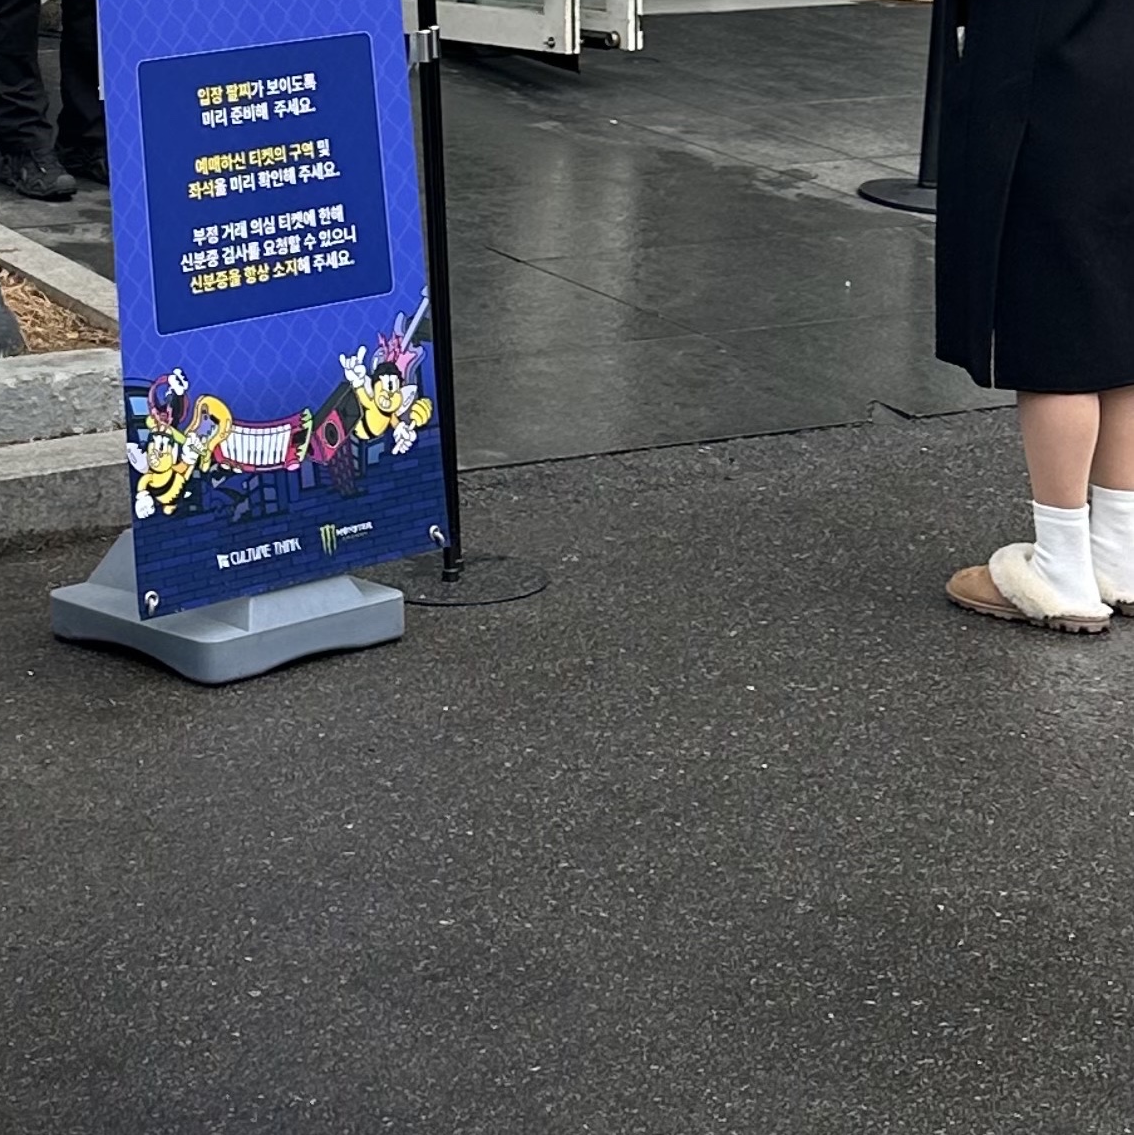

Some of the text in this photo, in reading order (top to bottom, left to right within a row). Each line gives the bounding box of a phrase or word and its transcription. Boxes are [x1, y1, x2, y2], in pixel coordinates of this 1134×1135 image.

[197, 87, 223, 106] 입장
[266, 73, 317, 96] 보이도록
[202, 97, 317, 128] 미리 준비해 주세요.
[194, 153, 247, 175] 예매하신
[249, 145, 287, 167] 티켓의
[289, 141, 315, 159] 구역
[187, 161, 341, 200] 좌석을 미리 확인해 주세요.
[192, 203, 345, 246] 부정 거래 의심 티켓에 한해
[180, 224, 358, 272] 신분증 검사를 요청할 수 있으니
[189, 249, 355, 294] 신분증을 항상 소지해 주세요.
